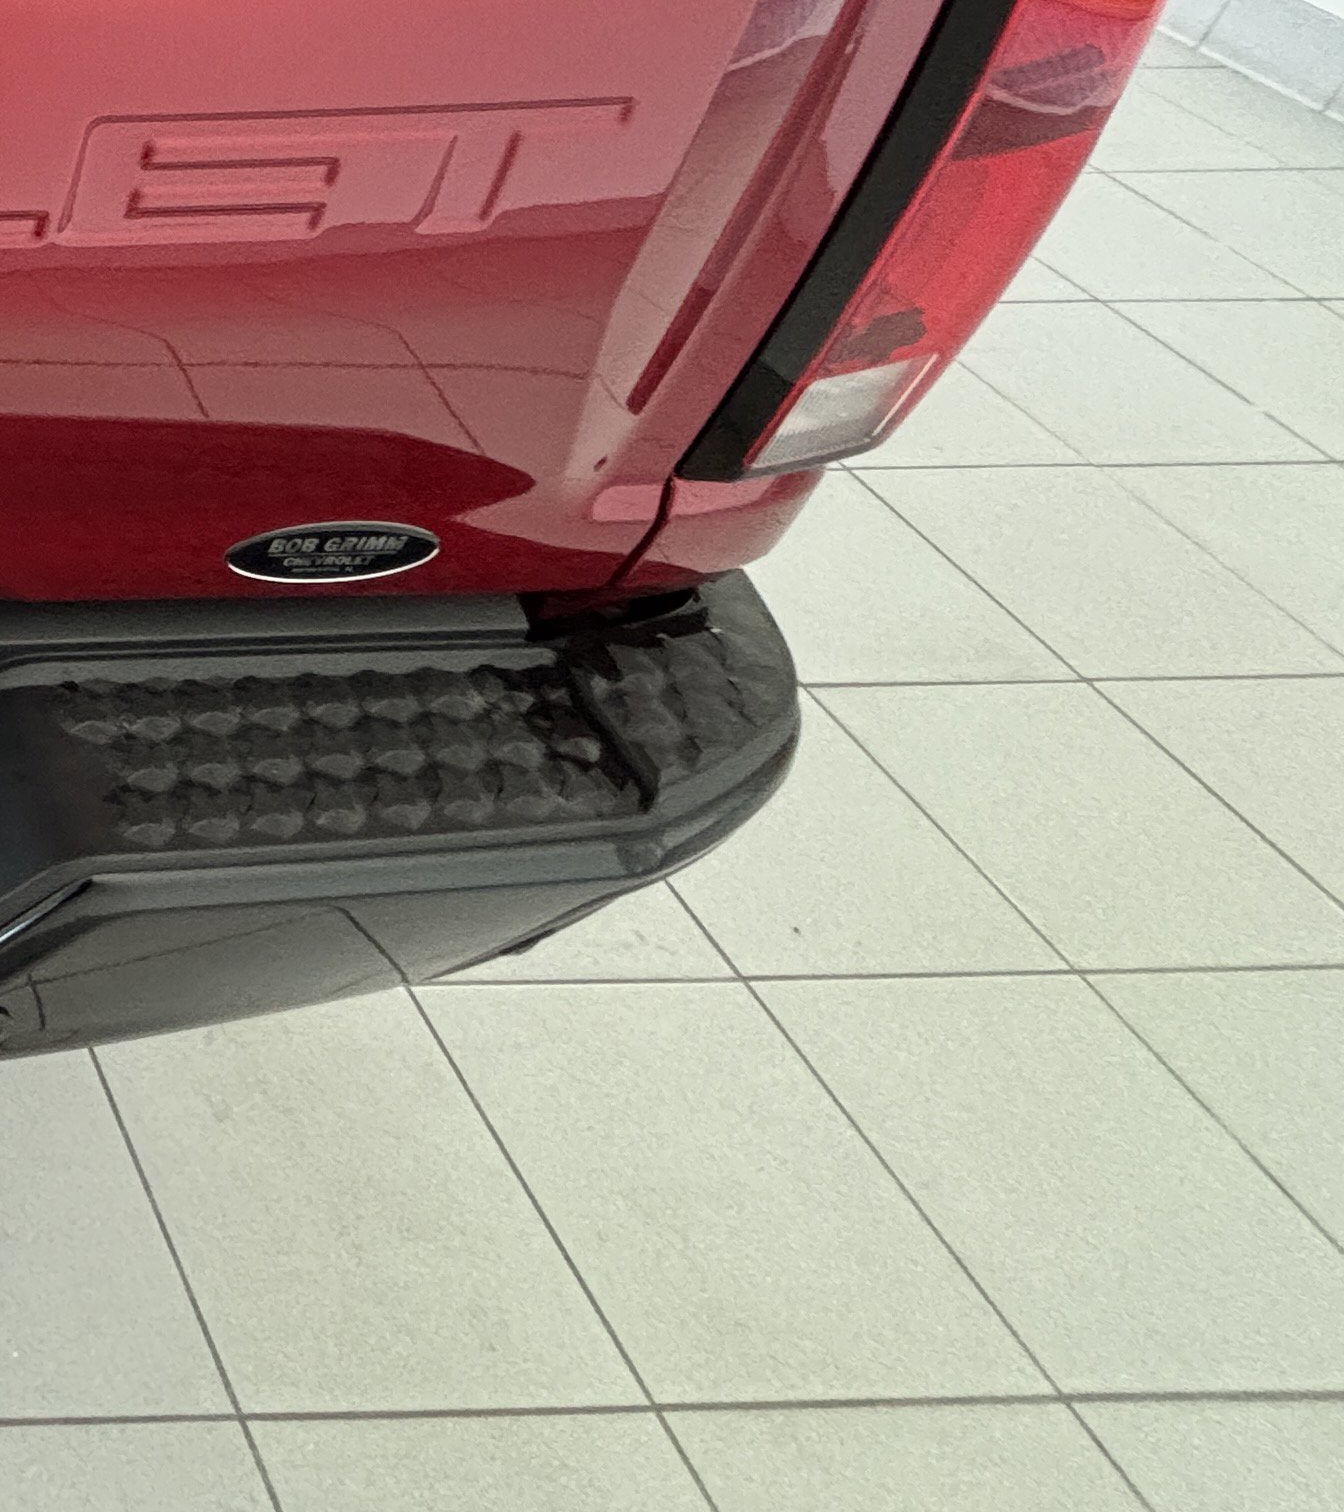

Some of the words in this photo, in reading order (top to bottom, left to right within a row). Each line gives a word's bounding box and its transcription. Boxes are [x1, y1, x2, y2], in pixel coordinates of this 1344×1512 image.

[268, 538, 321, 554] BOB
[324, 536, 408, 552] GRIMM
[283, 555, 376, 567] CHEVROLET
